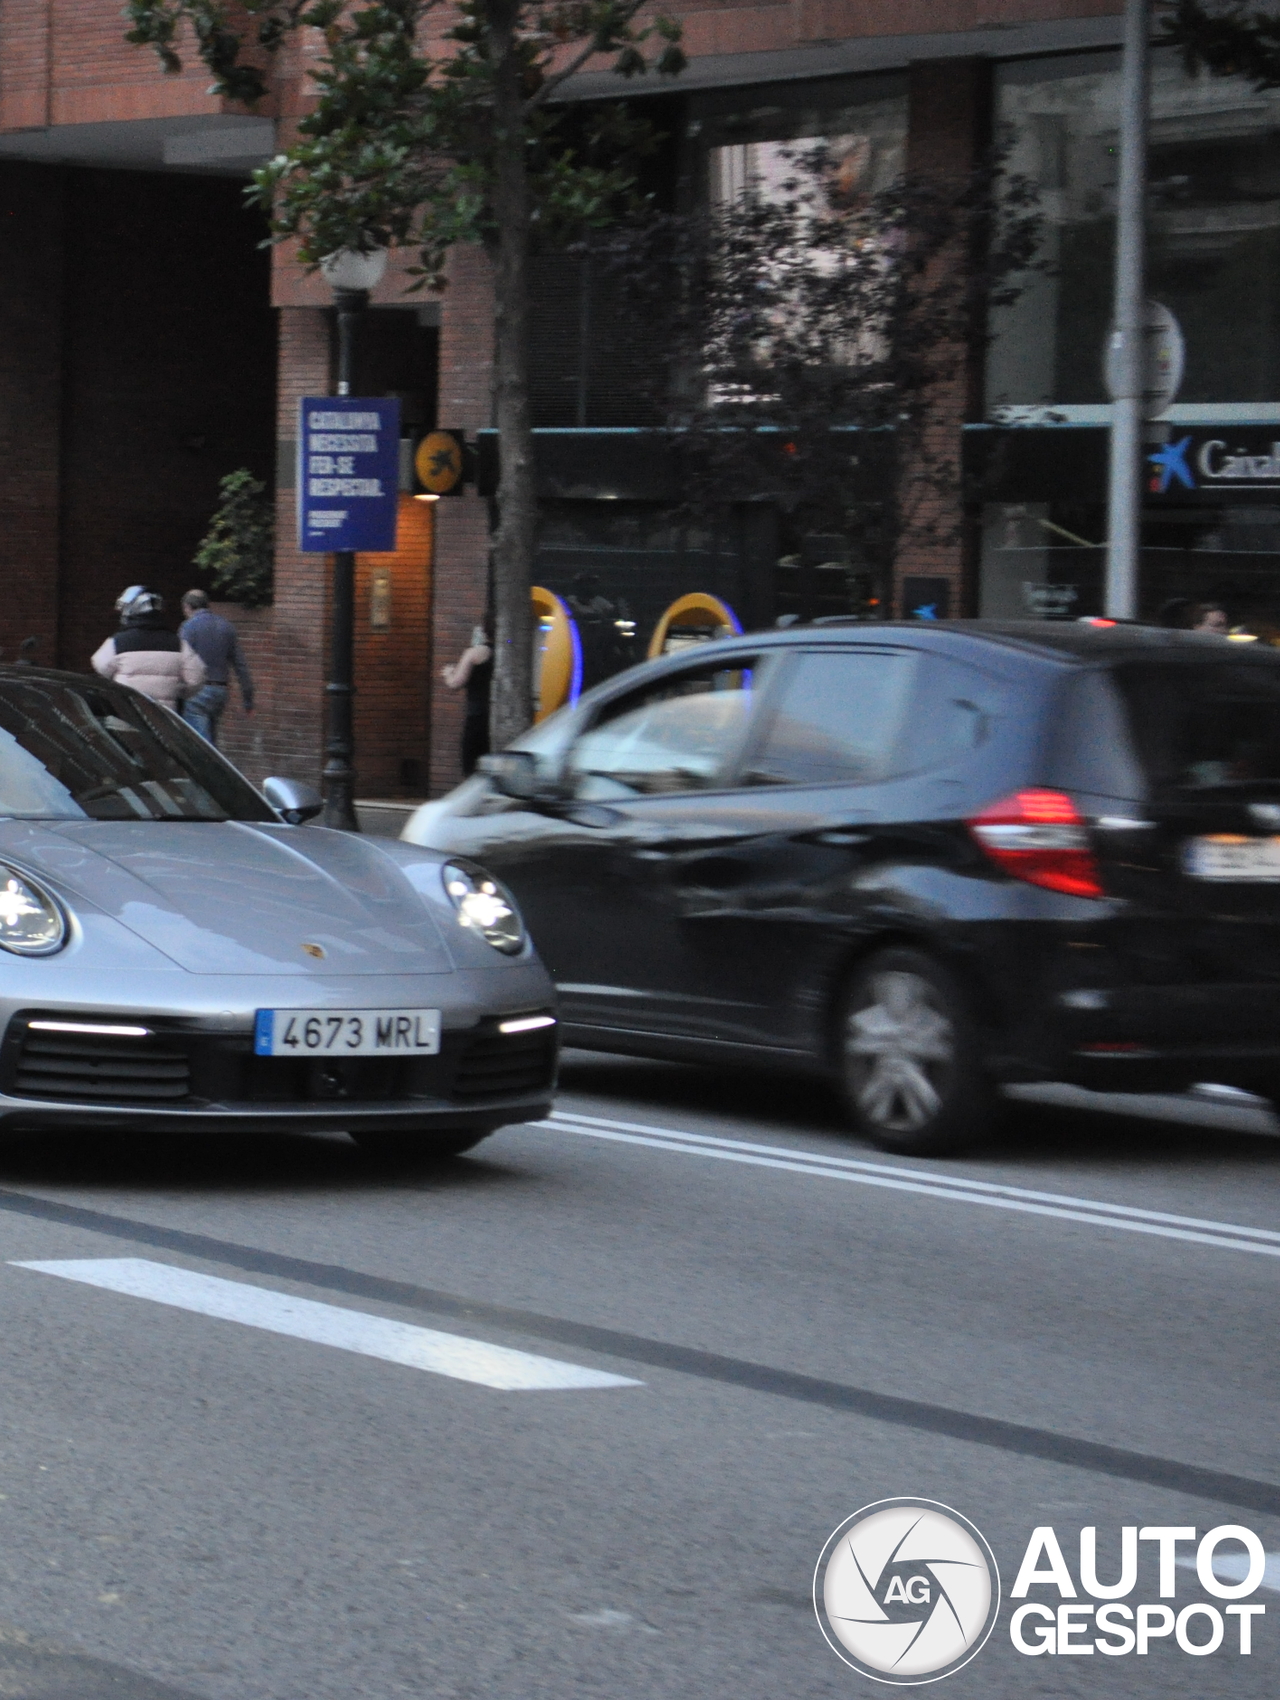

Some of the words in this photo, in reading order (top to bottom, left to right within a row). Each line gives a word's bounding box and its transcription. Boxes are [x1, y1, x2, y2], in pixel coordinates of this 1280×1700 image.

[1197, 440, 1280, 478] Caixa
[282, 1017, 363, 1049] 4673
[376, 1017, 430, 1048] MRL
